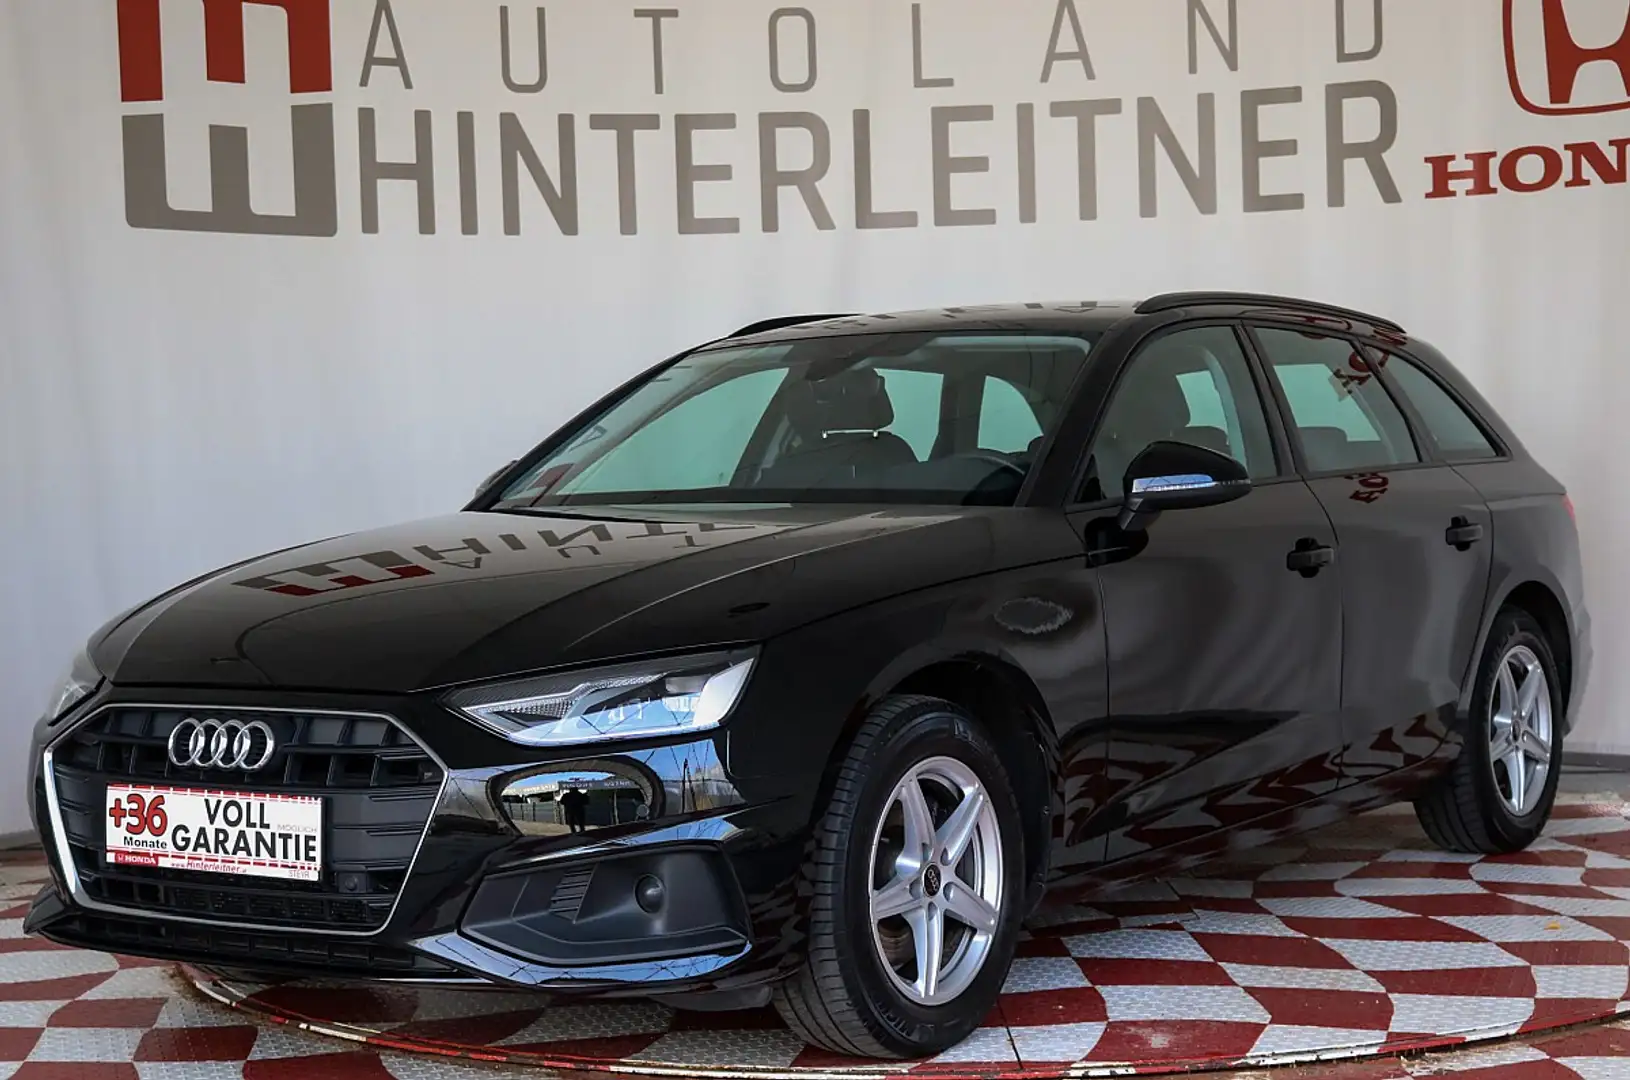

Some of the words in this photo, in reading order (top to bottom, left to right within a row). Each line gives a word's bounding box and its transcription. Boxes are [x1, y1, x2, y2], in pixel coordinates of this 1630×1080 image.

[359, 0, 1383, 94] AUTOLAND
[358, 80, 1402, 236] HINTERLEITNER
[109, 793, 168, 837] +36
[205, 799, 270, 829] VOLL
[123, 836, 167, 849] Monate
[124, 855, 156, 865] HONDA
[172, 825, 317, 863] GARANTIE
